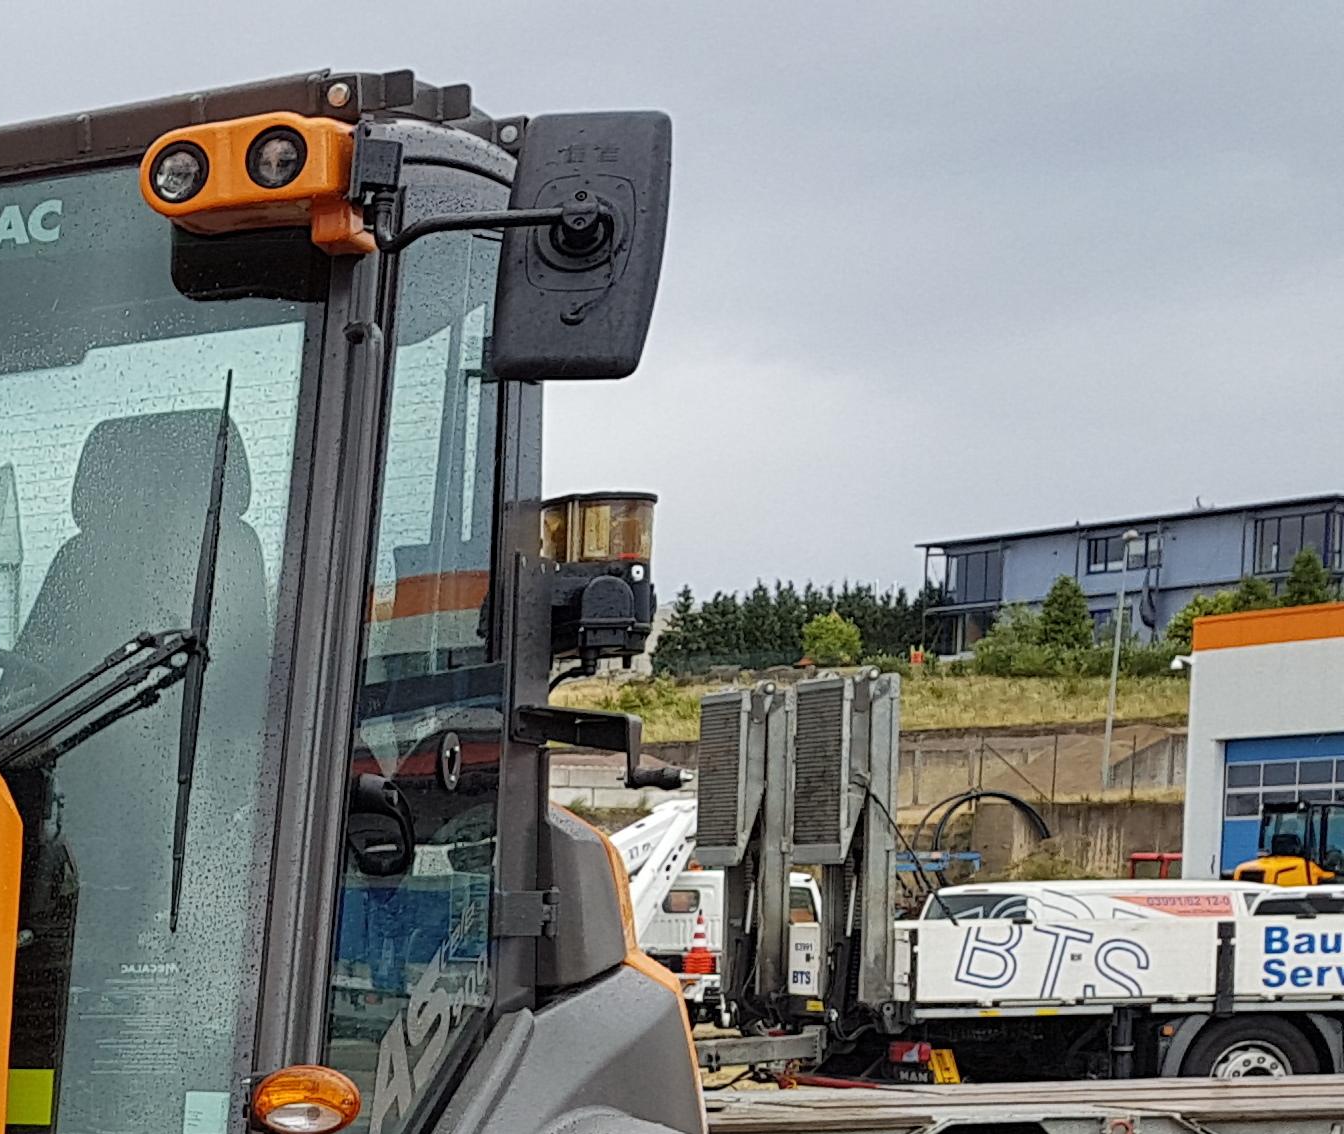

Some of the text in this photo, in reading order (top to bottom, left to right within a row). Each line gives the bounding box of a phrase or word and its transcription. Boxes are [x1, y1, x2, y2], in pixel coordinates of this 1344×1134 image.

[1264, 926, 1342, 954] Bau
[792, 970, 811, 985] BTS
[899, 1070, 928, 1082] MAN
